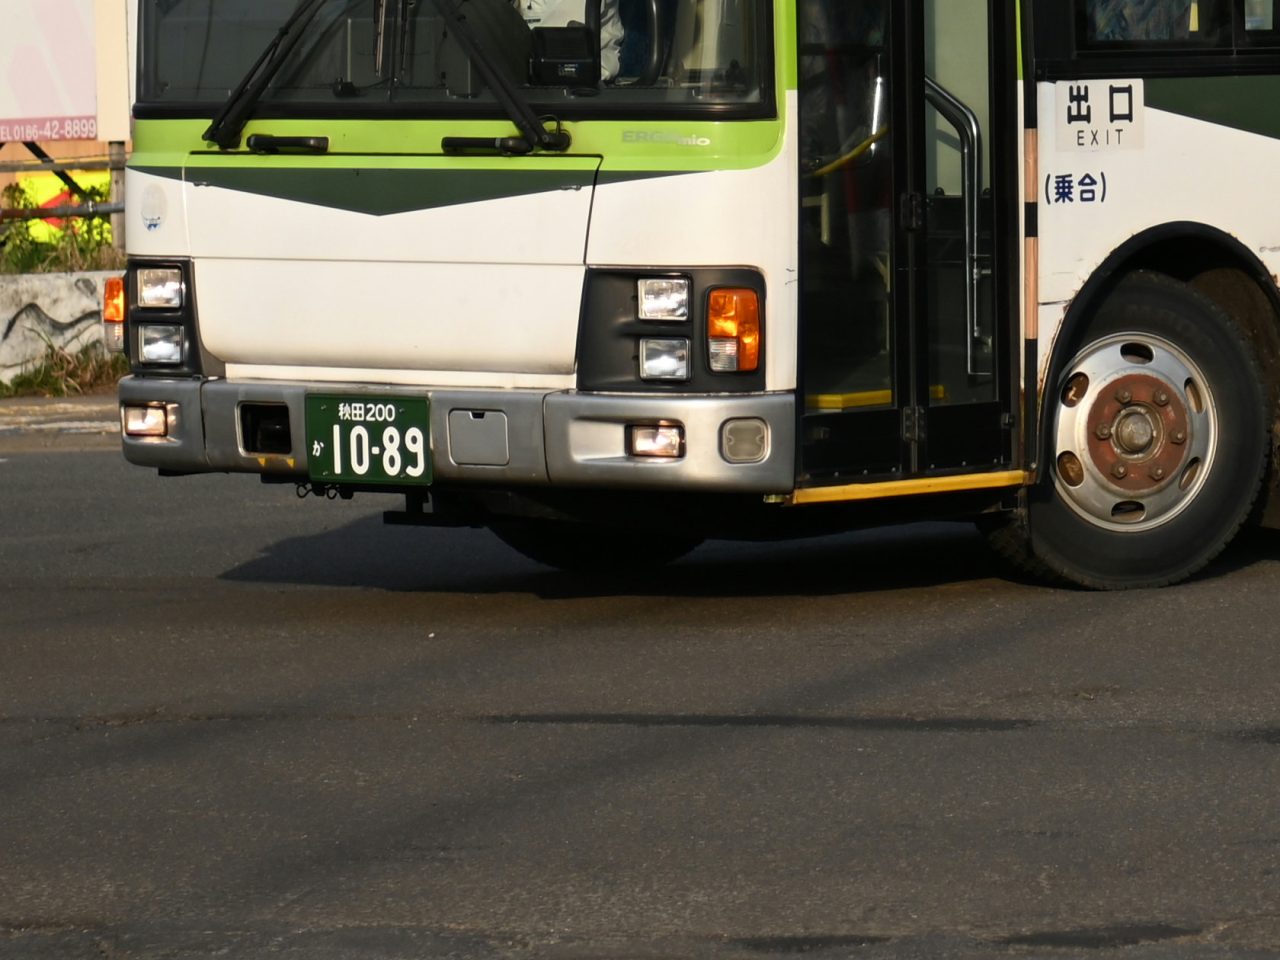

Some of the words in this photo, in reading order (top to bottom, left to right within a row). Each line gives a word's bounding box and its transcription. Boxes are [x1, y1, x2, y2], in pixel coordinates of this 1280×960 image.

[1067, 84, 1133, 124] 出口
[0, 126, 12, 140] EL
[1077, 129, 1123, 146] EXIT
[1045, 171, 1107, 205] (乗合)
[338, 402, 396, 421] 秋田200
[312, 440, 325, 457] か
[333, 424, 425, 477] 10-89
